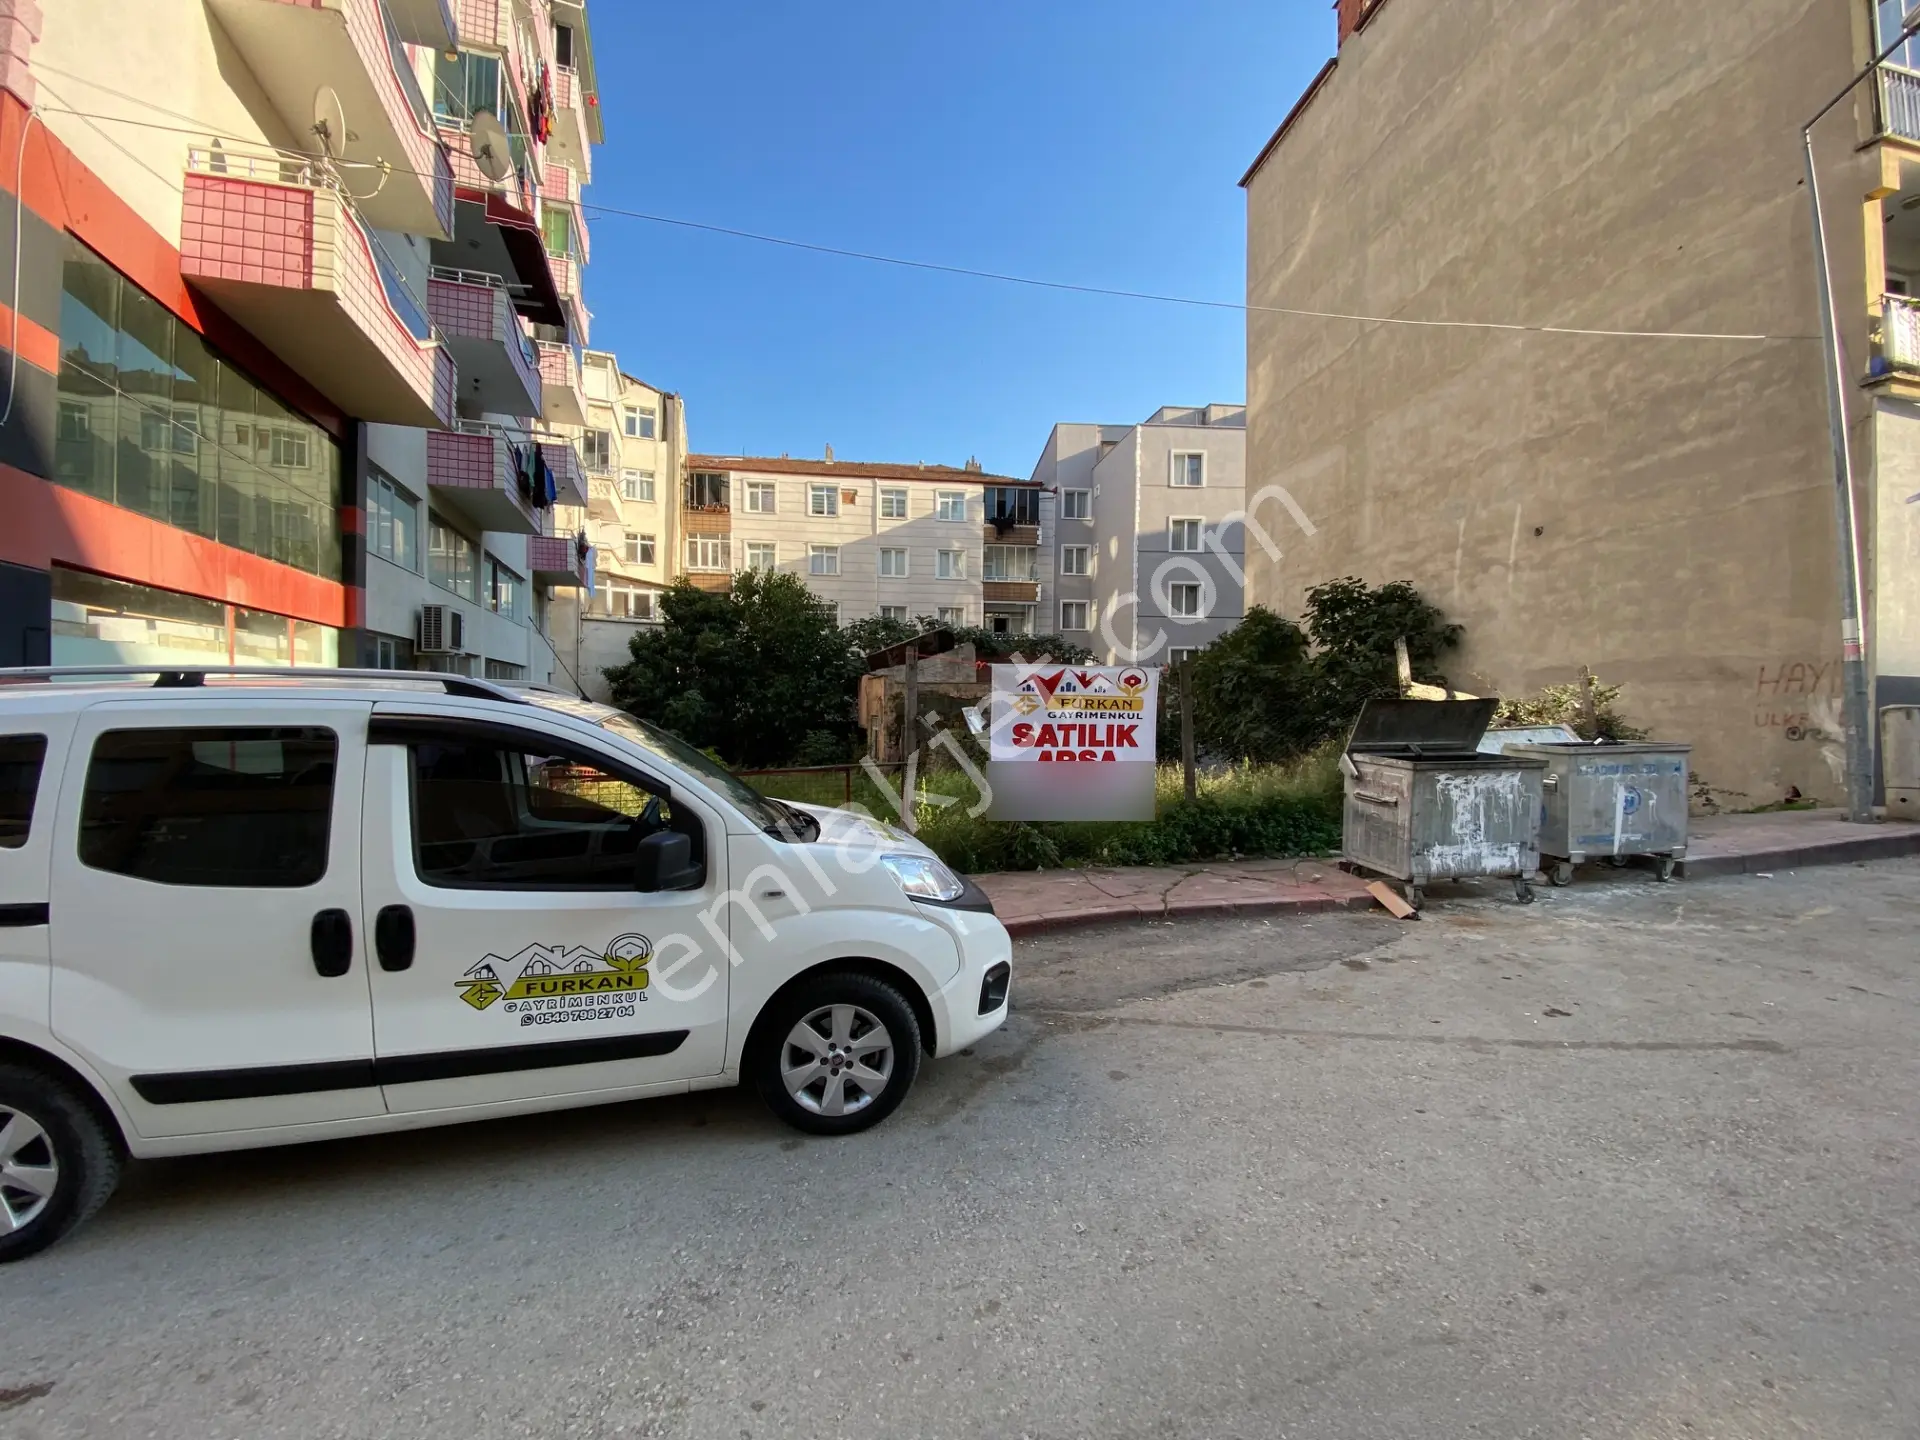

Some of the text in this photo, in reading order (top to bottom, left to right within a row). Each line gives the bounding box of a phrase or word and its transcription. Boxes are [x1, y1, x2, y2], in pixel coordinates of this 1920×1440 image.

[1060, 698, 1133, 710] FURKAN
[1047, 711, 1144, 720] GAYRİMENKUL
[1012, 723, 1139, 748] SATILIK
[525, 975, 633, 995] FURKAN
[504, 991, 649, 1012] GAYRİMENKUL
[534, 1005, 635, 1024] 0546 798 27 04
